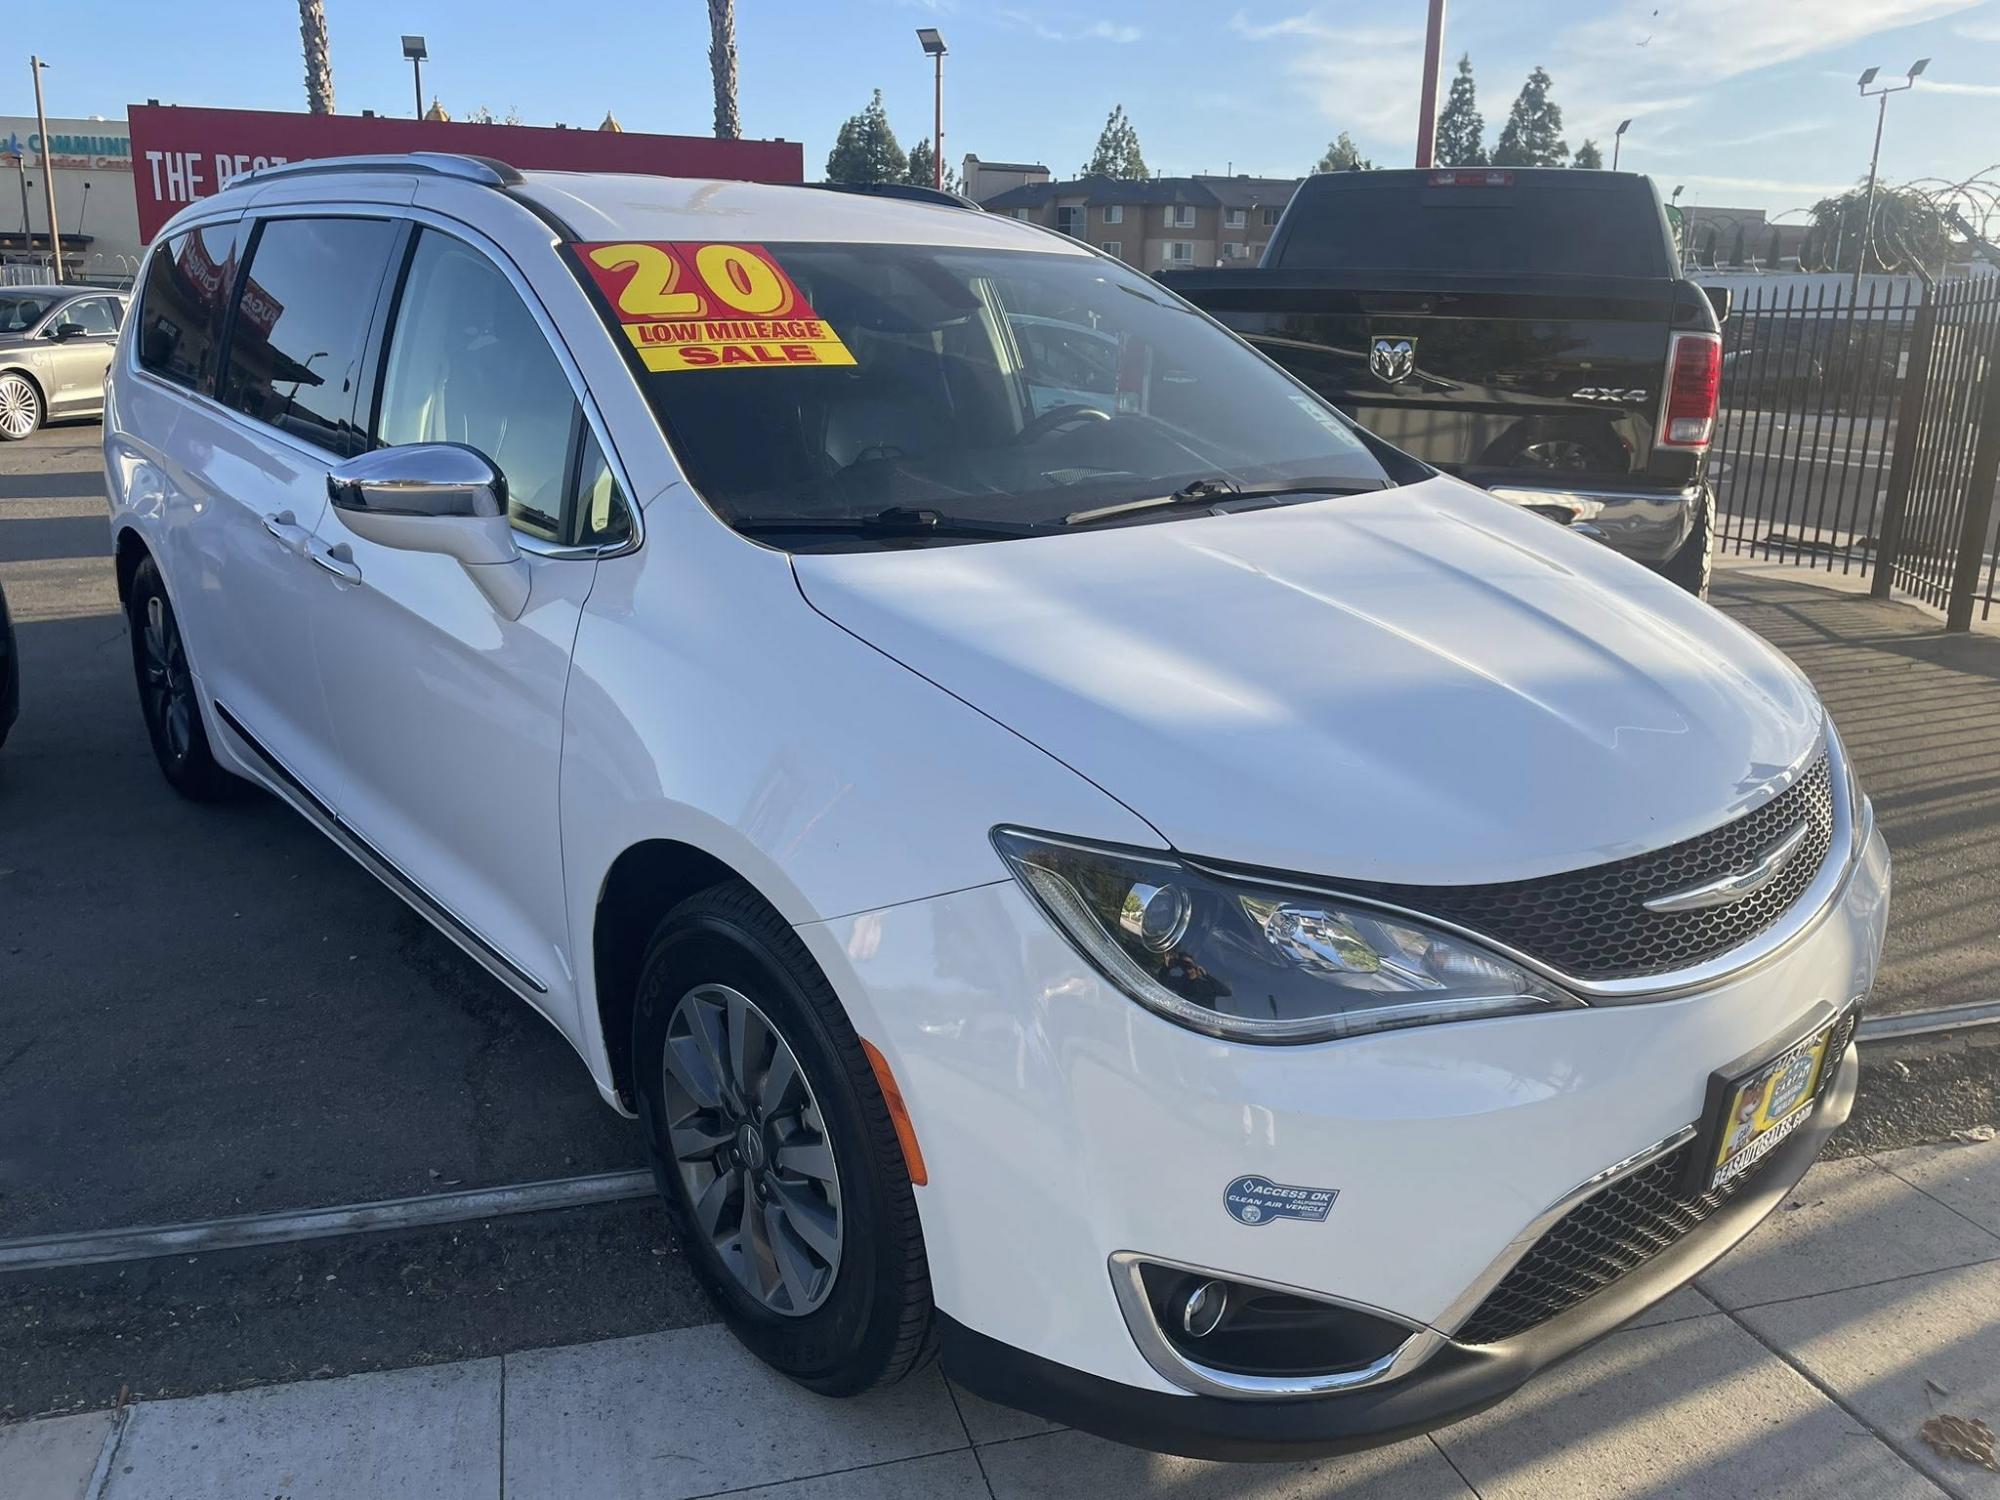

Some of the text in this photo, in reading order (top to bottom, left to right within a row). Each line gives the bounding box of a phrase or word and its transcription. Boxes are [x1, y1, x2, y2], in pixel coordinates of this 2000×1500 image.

[145, 151, 205, 202] THE
[589, 244, 794, 318] 20
[637, 319, 826, 345] LOW MILEAGE
[678, 345, 821, 366] SALE
[1228, 1194, 1326, 1212] CLEAN AIR VEHICLE
[1254, 1185, 1332, 1202] ACCESS OK
